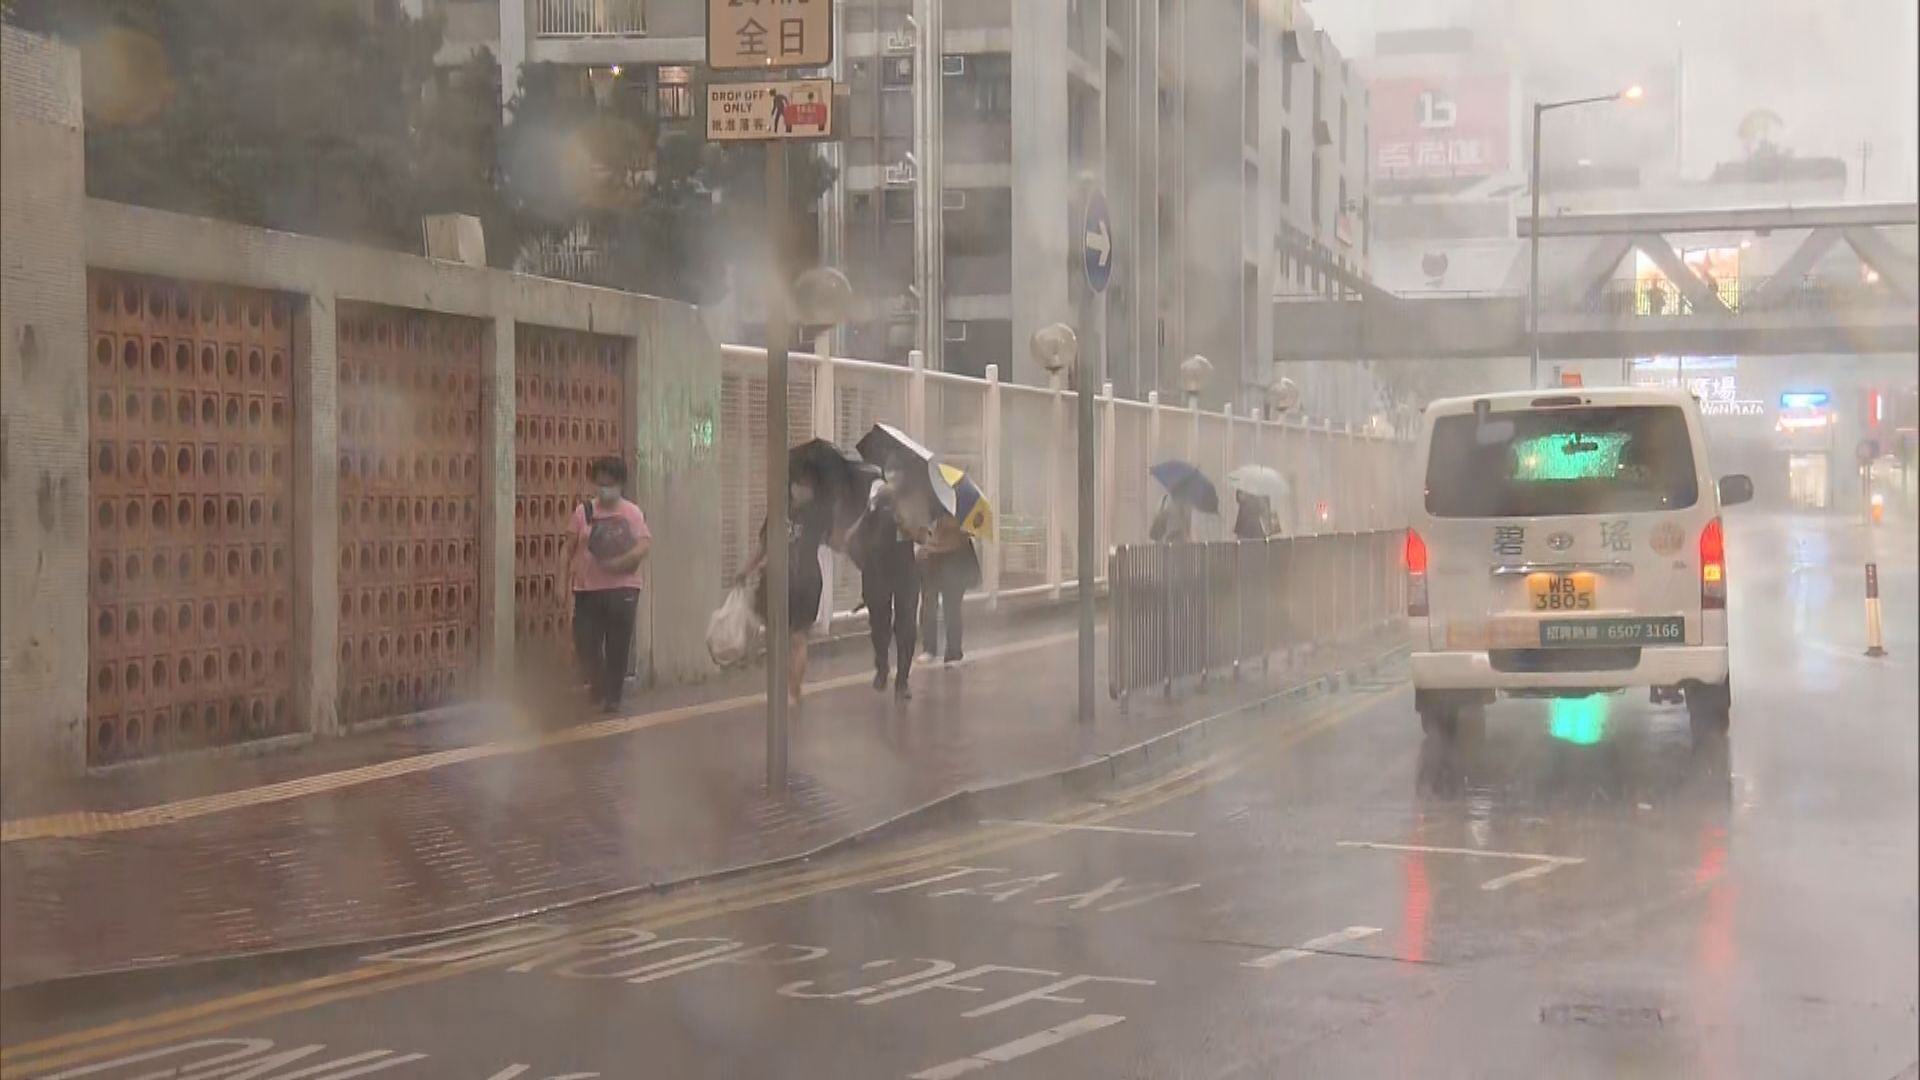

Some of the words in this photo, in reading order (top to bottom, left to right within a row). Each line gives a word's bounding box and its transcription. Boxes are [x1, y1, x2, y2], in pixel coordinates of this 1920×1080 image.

[735, 17, 804, 56] 全日
[712, 91, 742, 102] DROP
[744, 89, 766, 101] OFF
[723, 102, 752, 113] ONLY
[1549, 577, 1576, 594] WB
[1535, 593, 1591, 610] 3805
[1607, 625, 1642, 639] 6507
[1645, 624, 1680, 638] 3166
